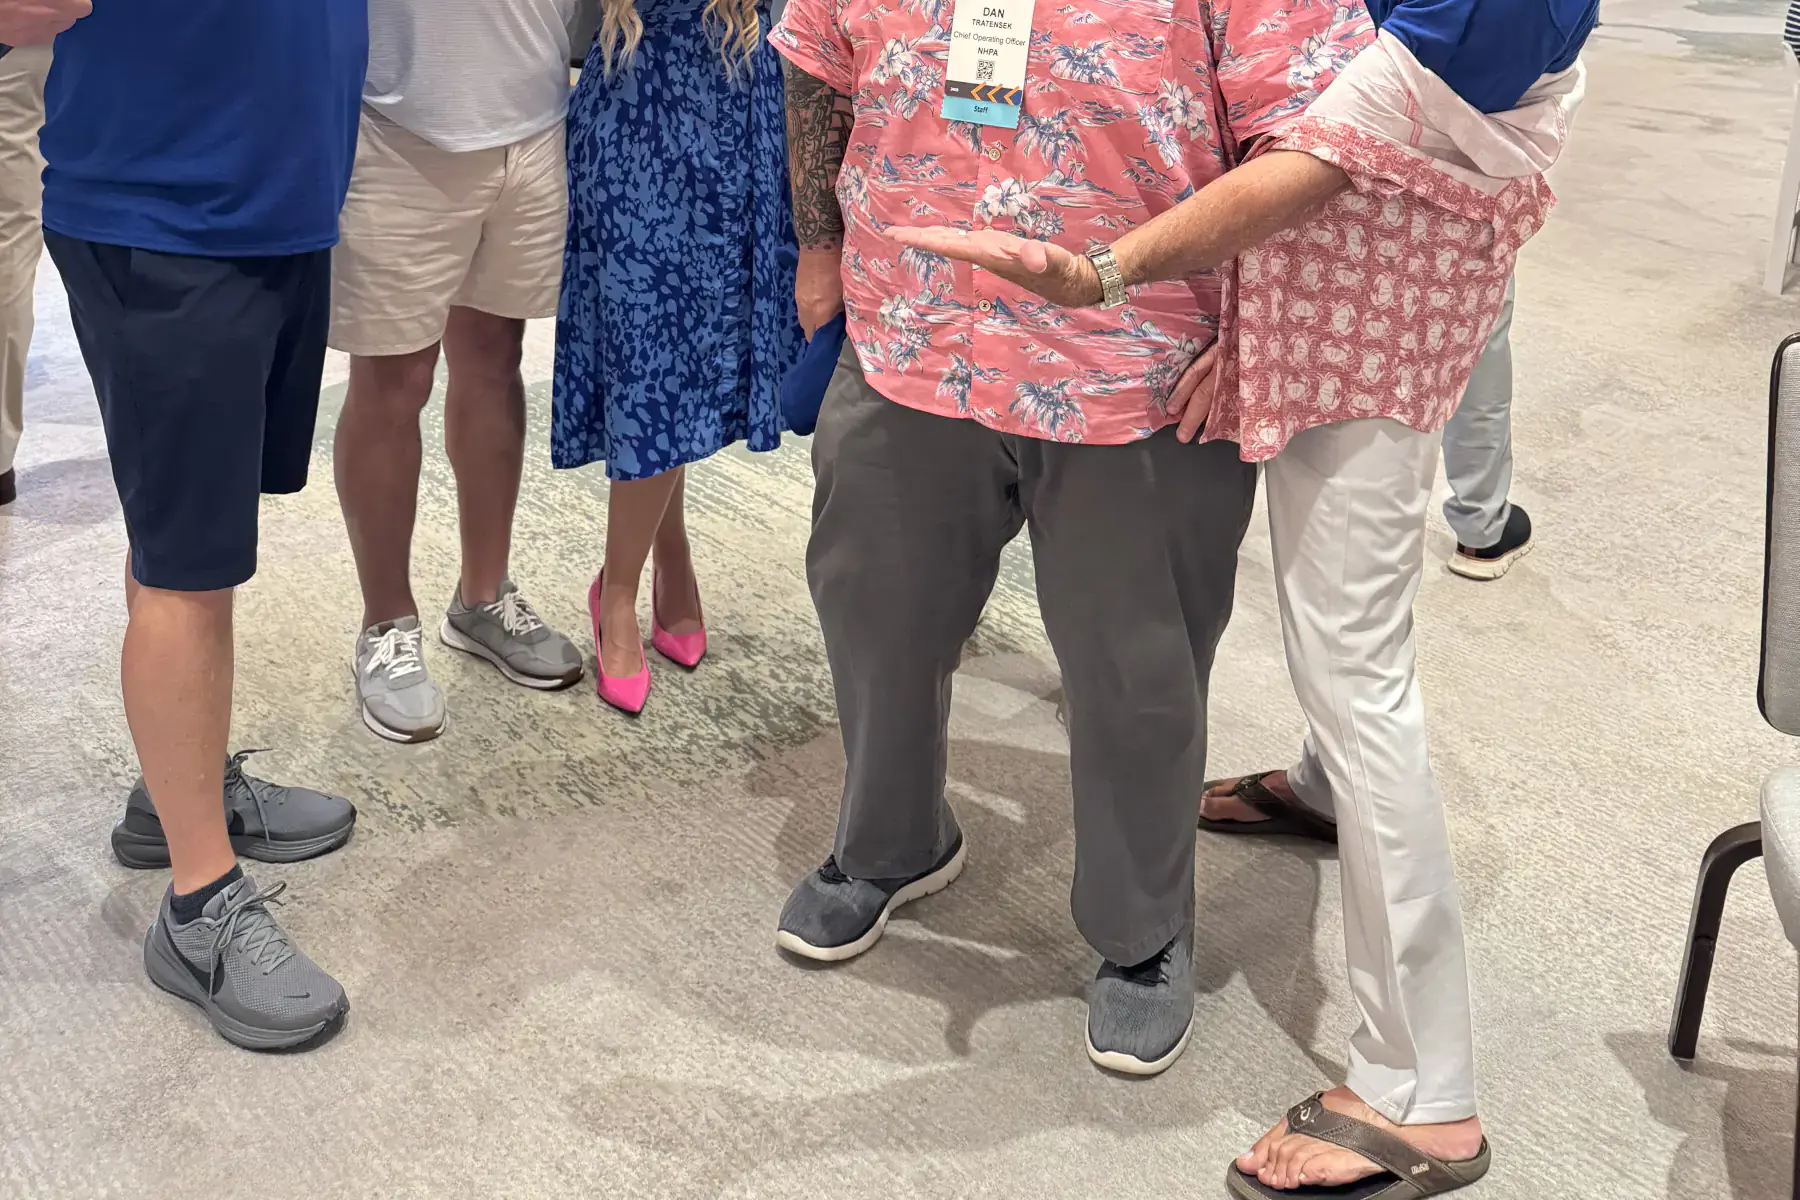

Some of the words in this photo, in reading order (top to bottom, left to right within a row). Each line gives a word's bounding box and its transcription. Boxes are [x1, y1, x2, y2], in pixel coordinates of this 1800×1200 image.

[982, 7, 1005, 19] DAN
[972, 18, 1013, 30] TRATENSEK
[953, 30, 972, 40] Chief
[972, 33, 1004, 46] Operating
[1005, 37, 1026, 47] Officer
[977, 46, 999, 57] NHPA
[973, 105, 989, 114] Staff
